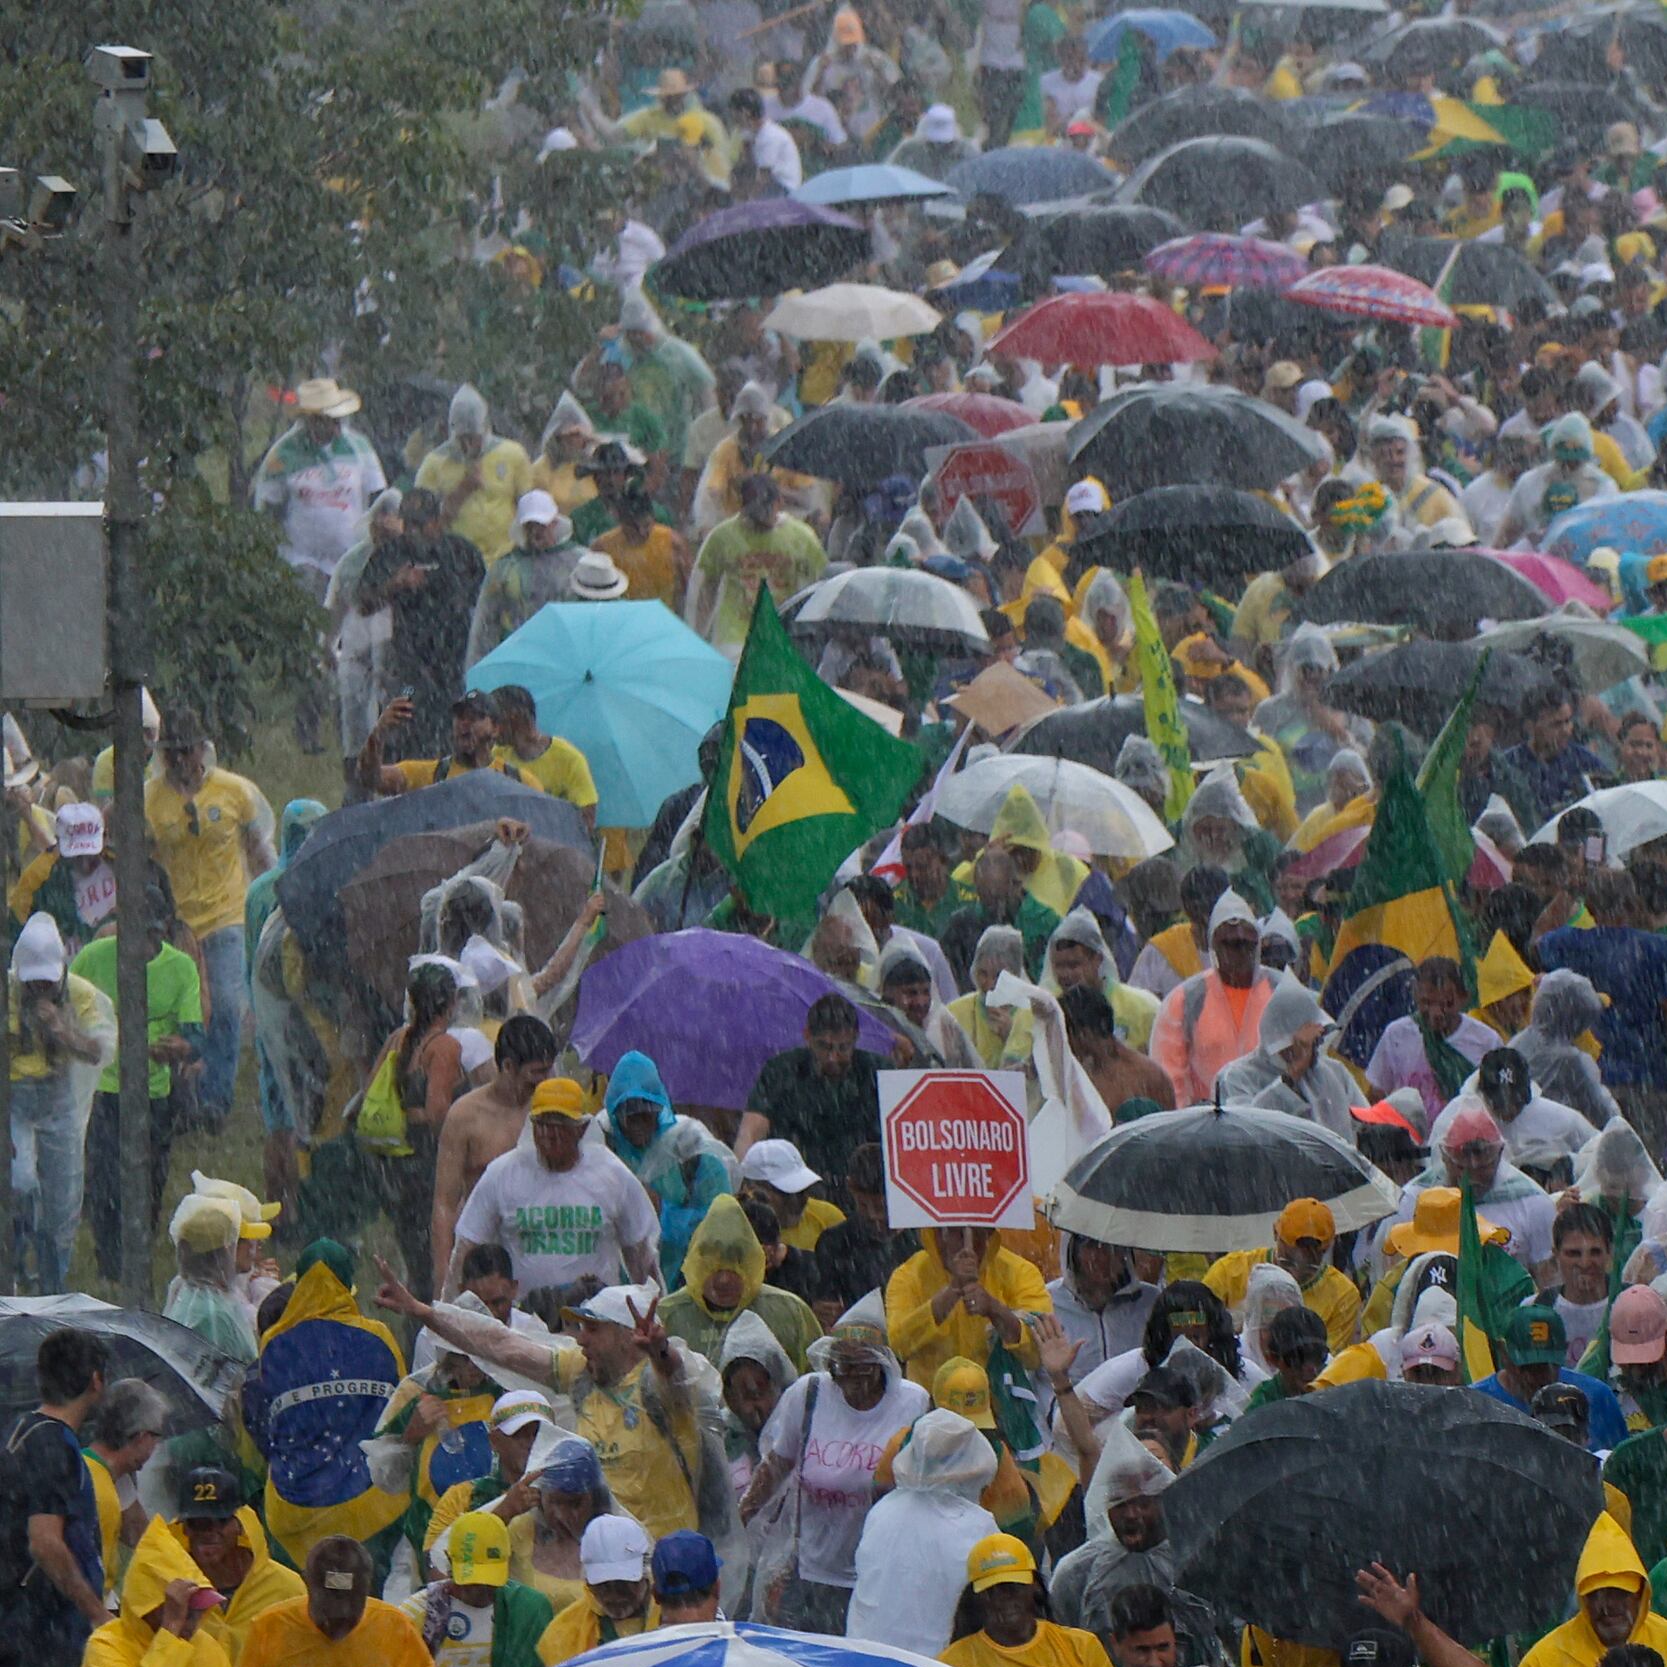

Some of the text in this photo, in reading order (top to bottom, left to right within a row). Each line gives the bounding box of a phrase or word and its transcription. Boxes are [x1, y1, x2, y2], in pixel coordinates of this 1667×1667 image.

[1499, 1067, 1514, 1085] NY
[901, 1119, 1013, 1152] BOLSONARO
[931, 1162, 994, 1199] LIVRE
[516, 1205, 602, 1229] ACORDA
[312, 1381, 388, 1398] PROGRES
[807, 1438, 884, 1471] ACORD
[193, 1483, 217, 1501] 22
